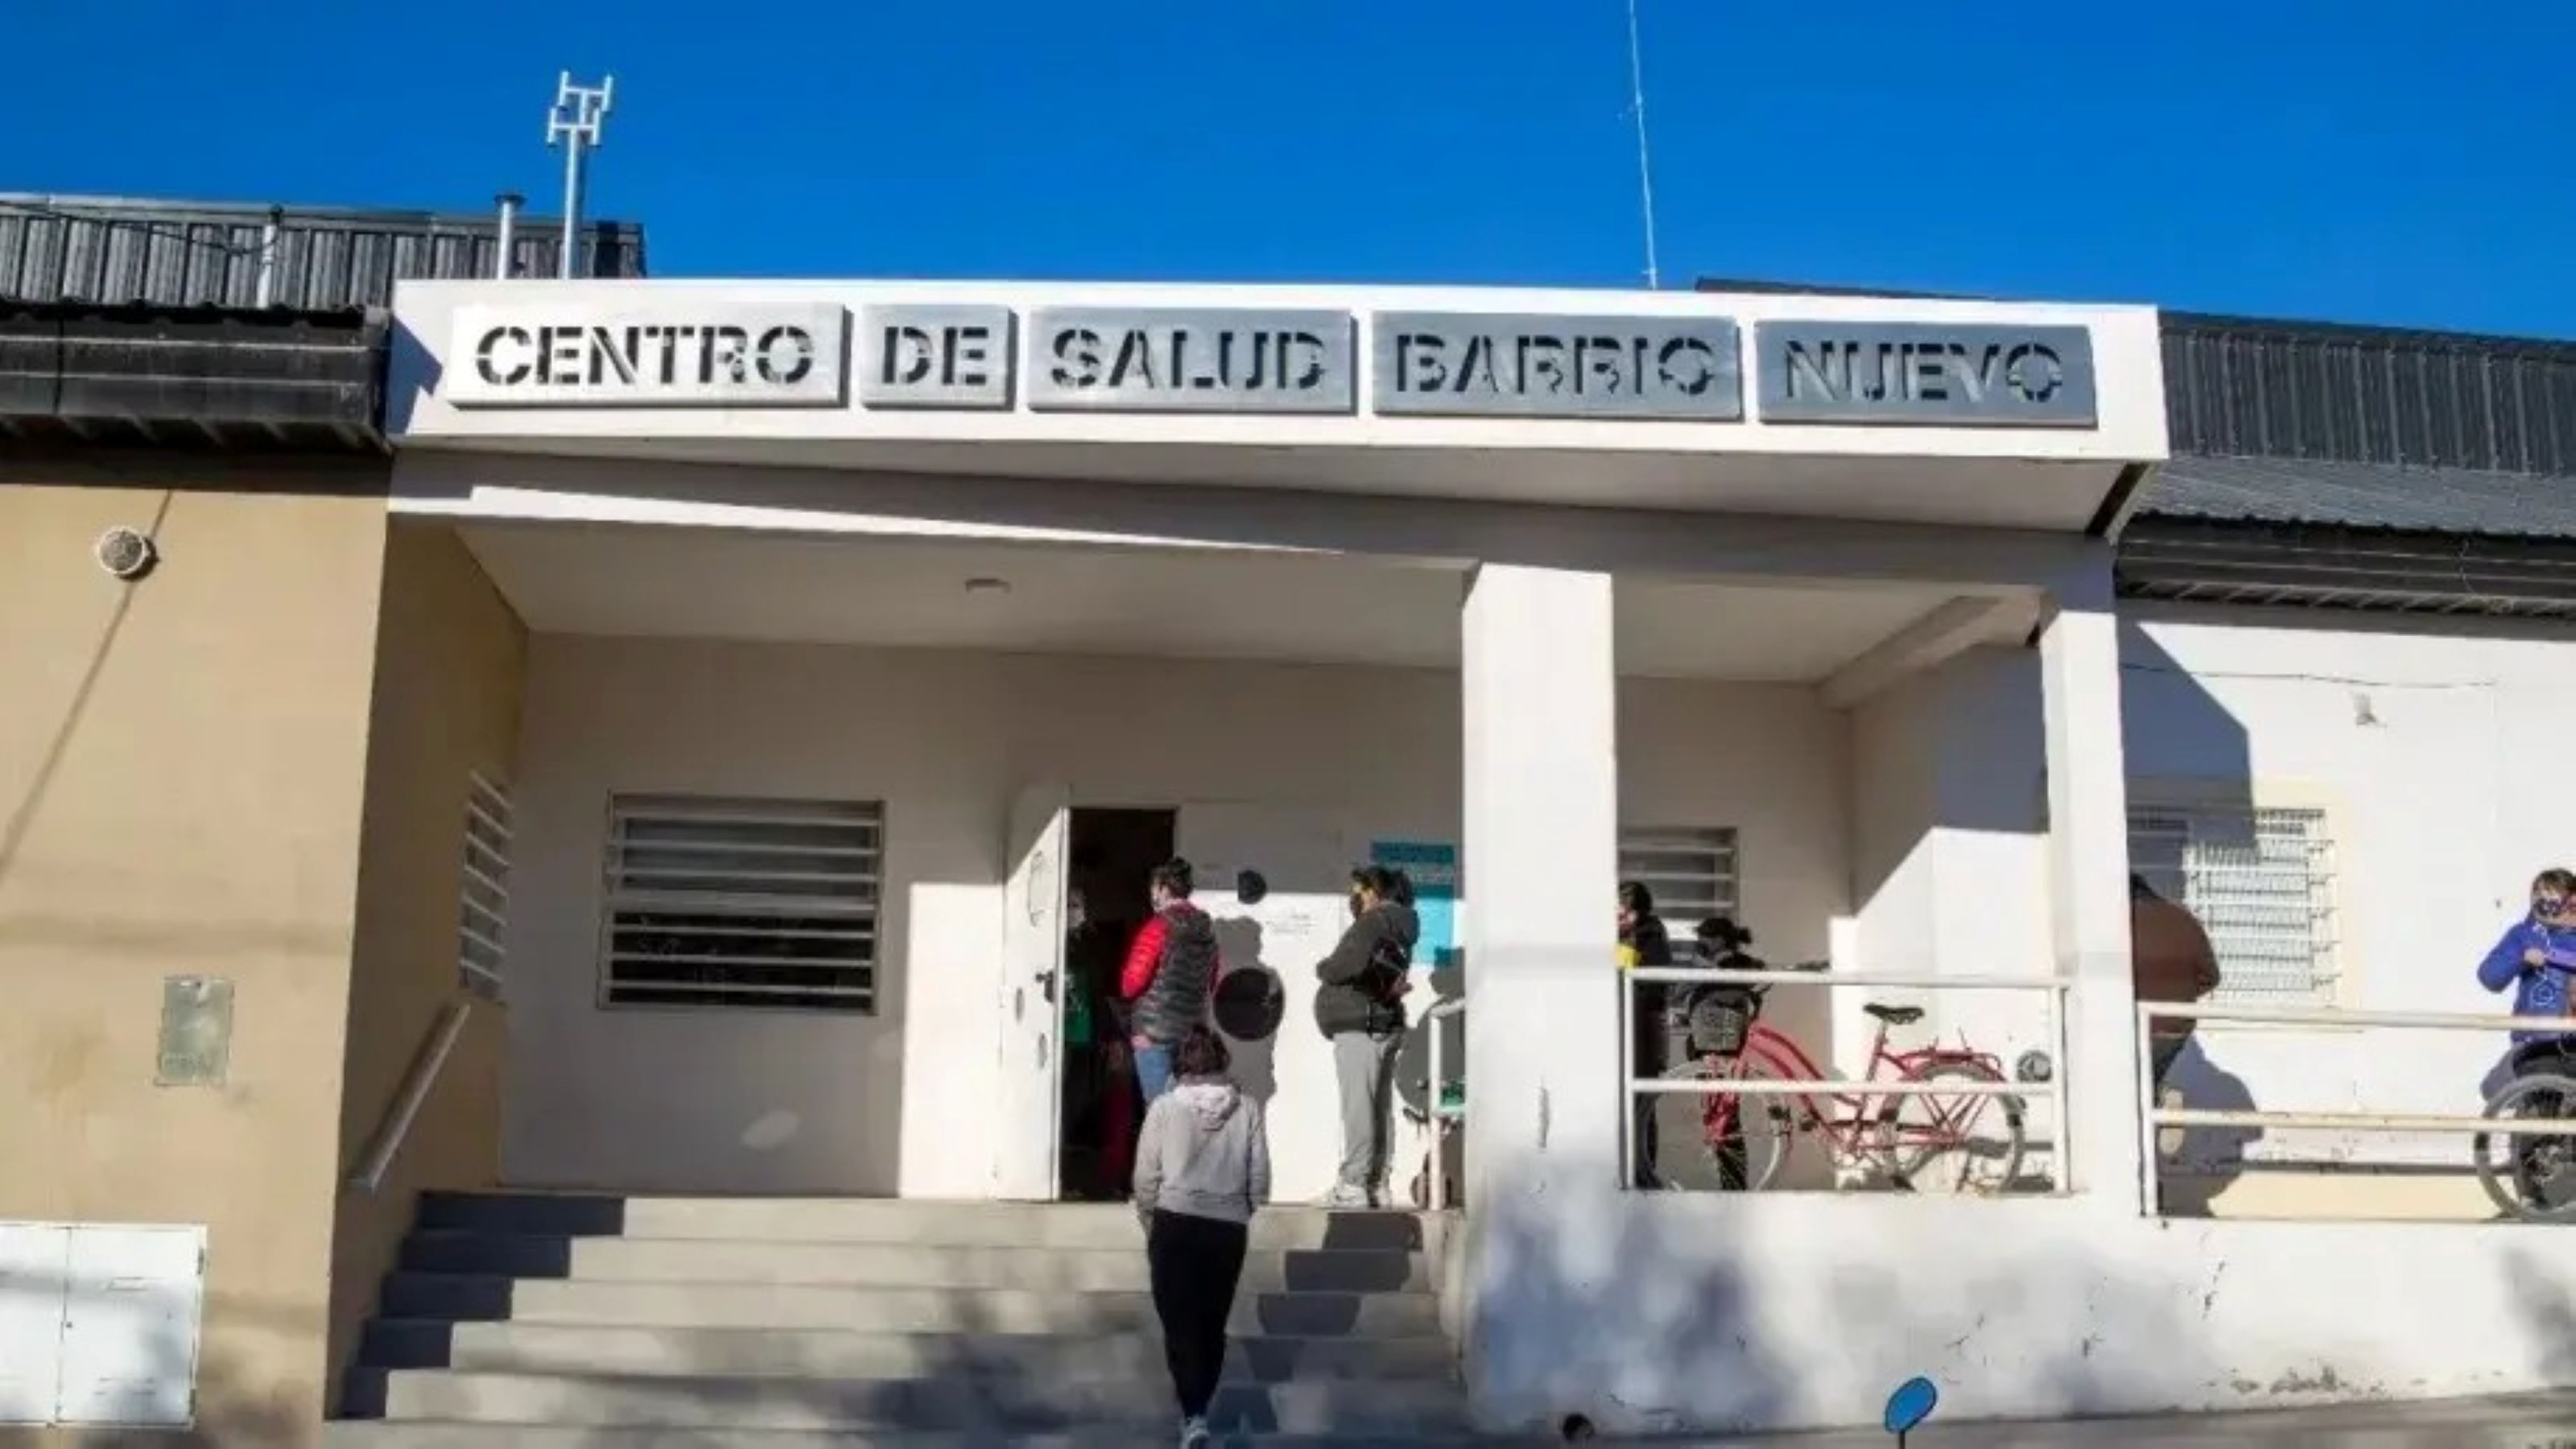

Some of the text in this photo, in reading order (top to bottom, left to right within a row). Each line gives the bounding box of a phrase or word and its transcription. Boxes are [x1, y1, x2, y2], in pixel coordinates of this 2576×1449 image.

[475, 325, 2062, 402] CENTRO DE SALUD BARRIO NUEVO
